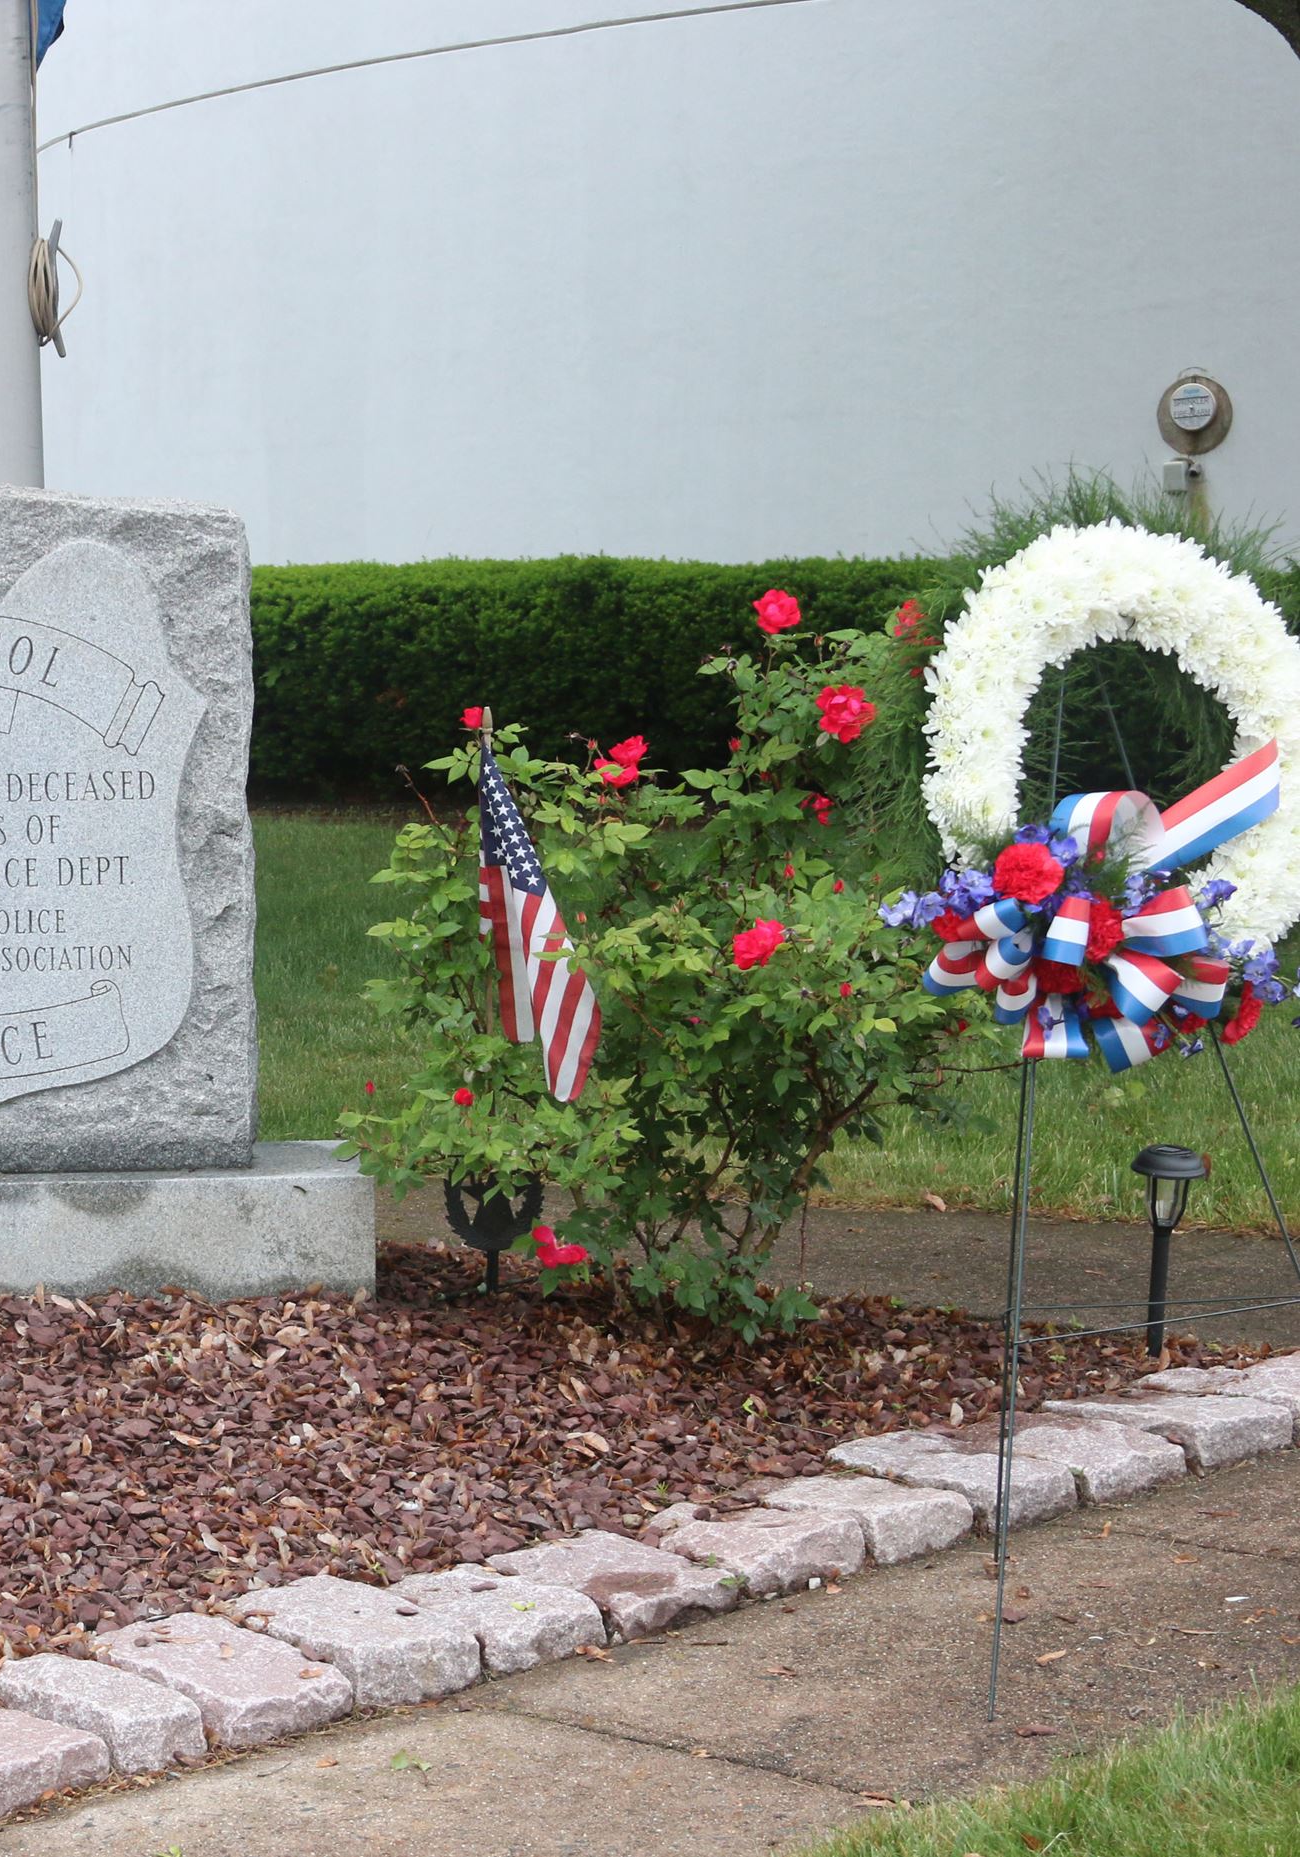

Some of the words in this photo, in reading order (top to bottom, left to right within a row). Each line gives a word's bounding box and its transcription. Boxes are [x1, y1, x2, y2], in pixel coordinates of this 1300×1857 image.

[6, 769, 156, 804] DECEASED
[26, 814, 62, 845] OF
[57, 855, 136, 887] DEPT.
